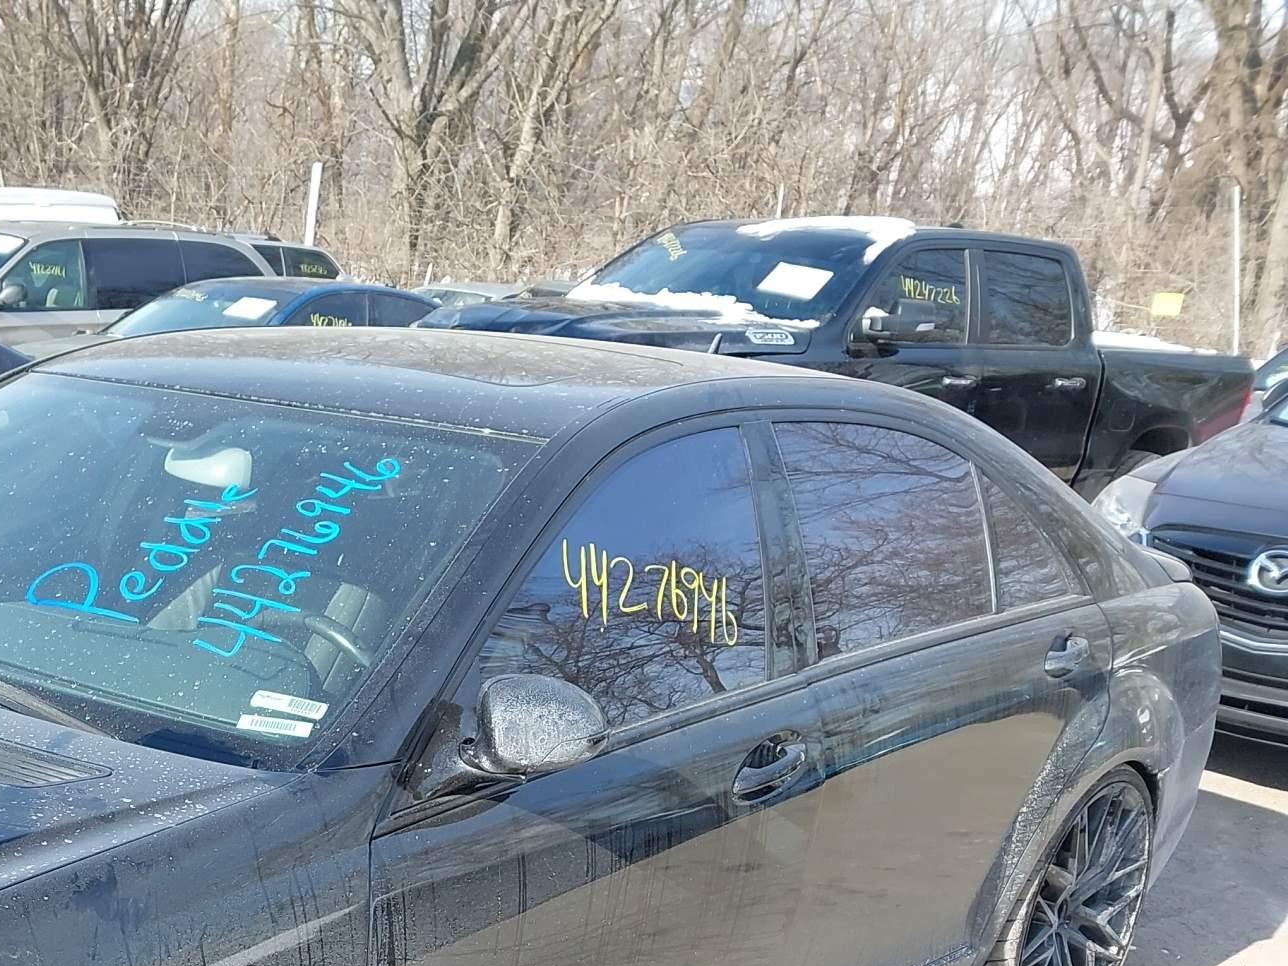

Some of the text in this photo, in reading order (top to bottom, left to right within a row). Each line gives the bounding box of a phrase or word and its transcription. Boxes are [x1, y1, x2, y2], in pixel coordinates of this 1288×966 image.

[900, 274, 961, 305] 44247226
[23, 483, 258, 626] Peddle
[193, 456, 403, 659] 44276946
[561, 537, 739, 647] 44276946
